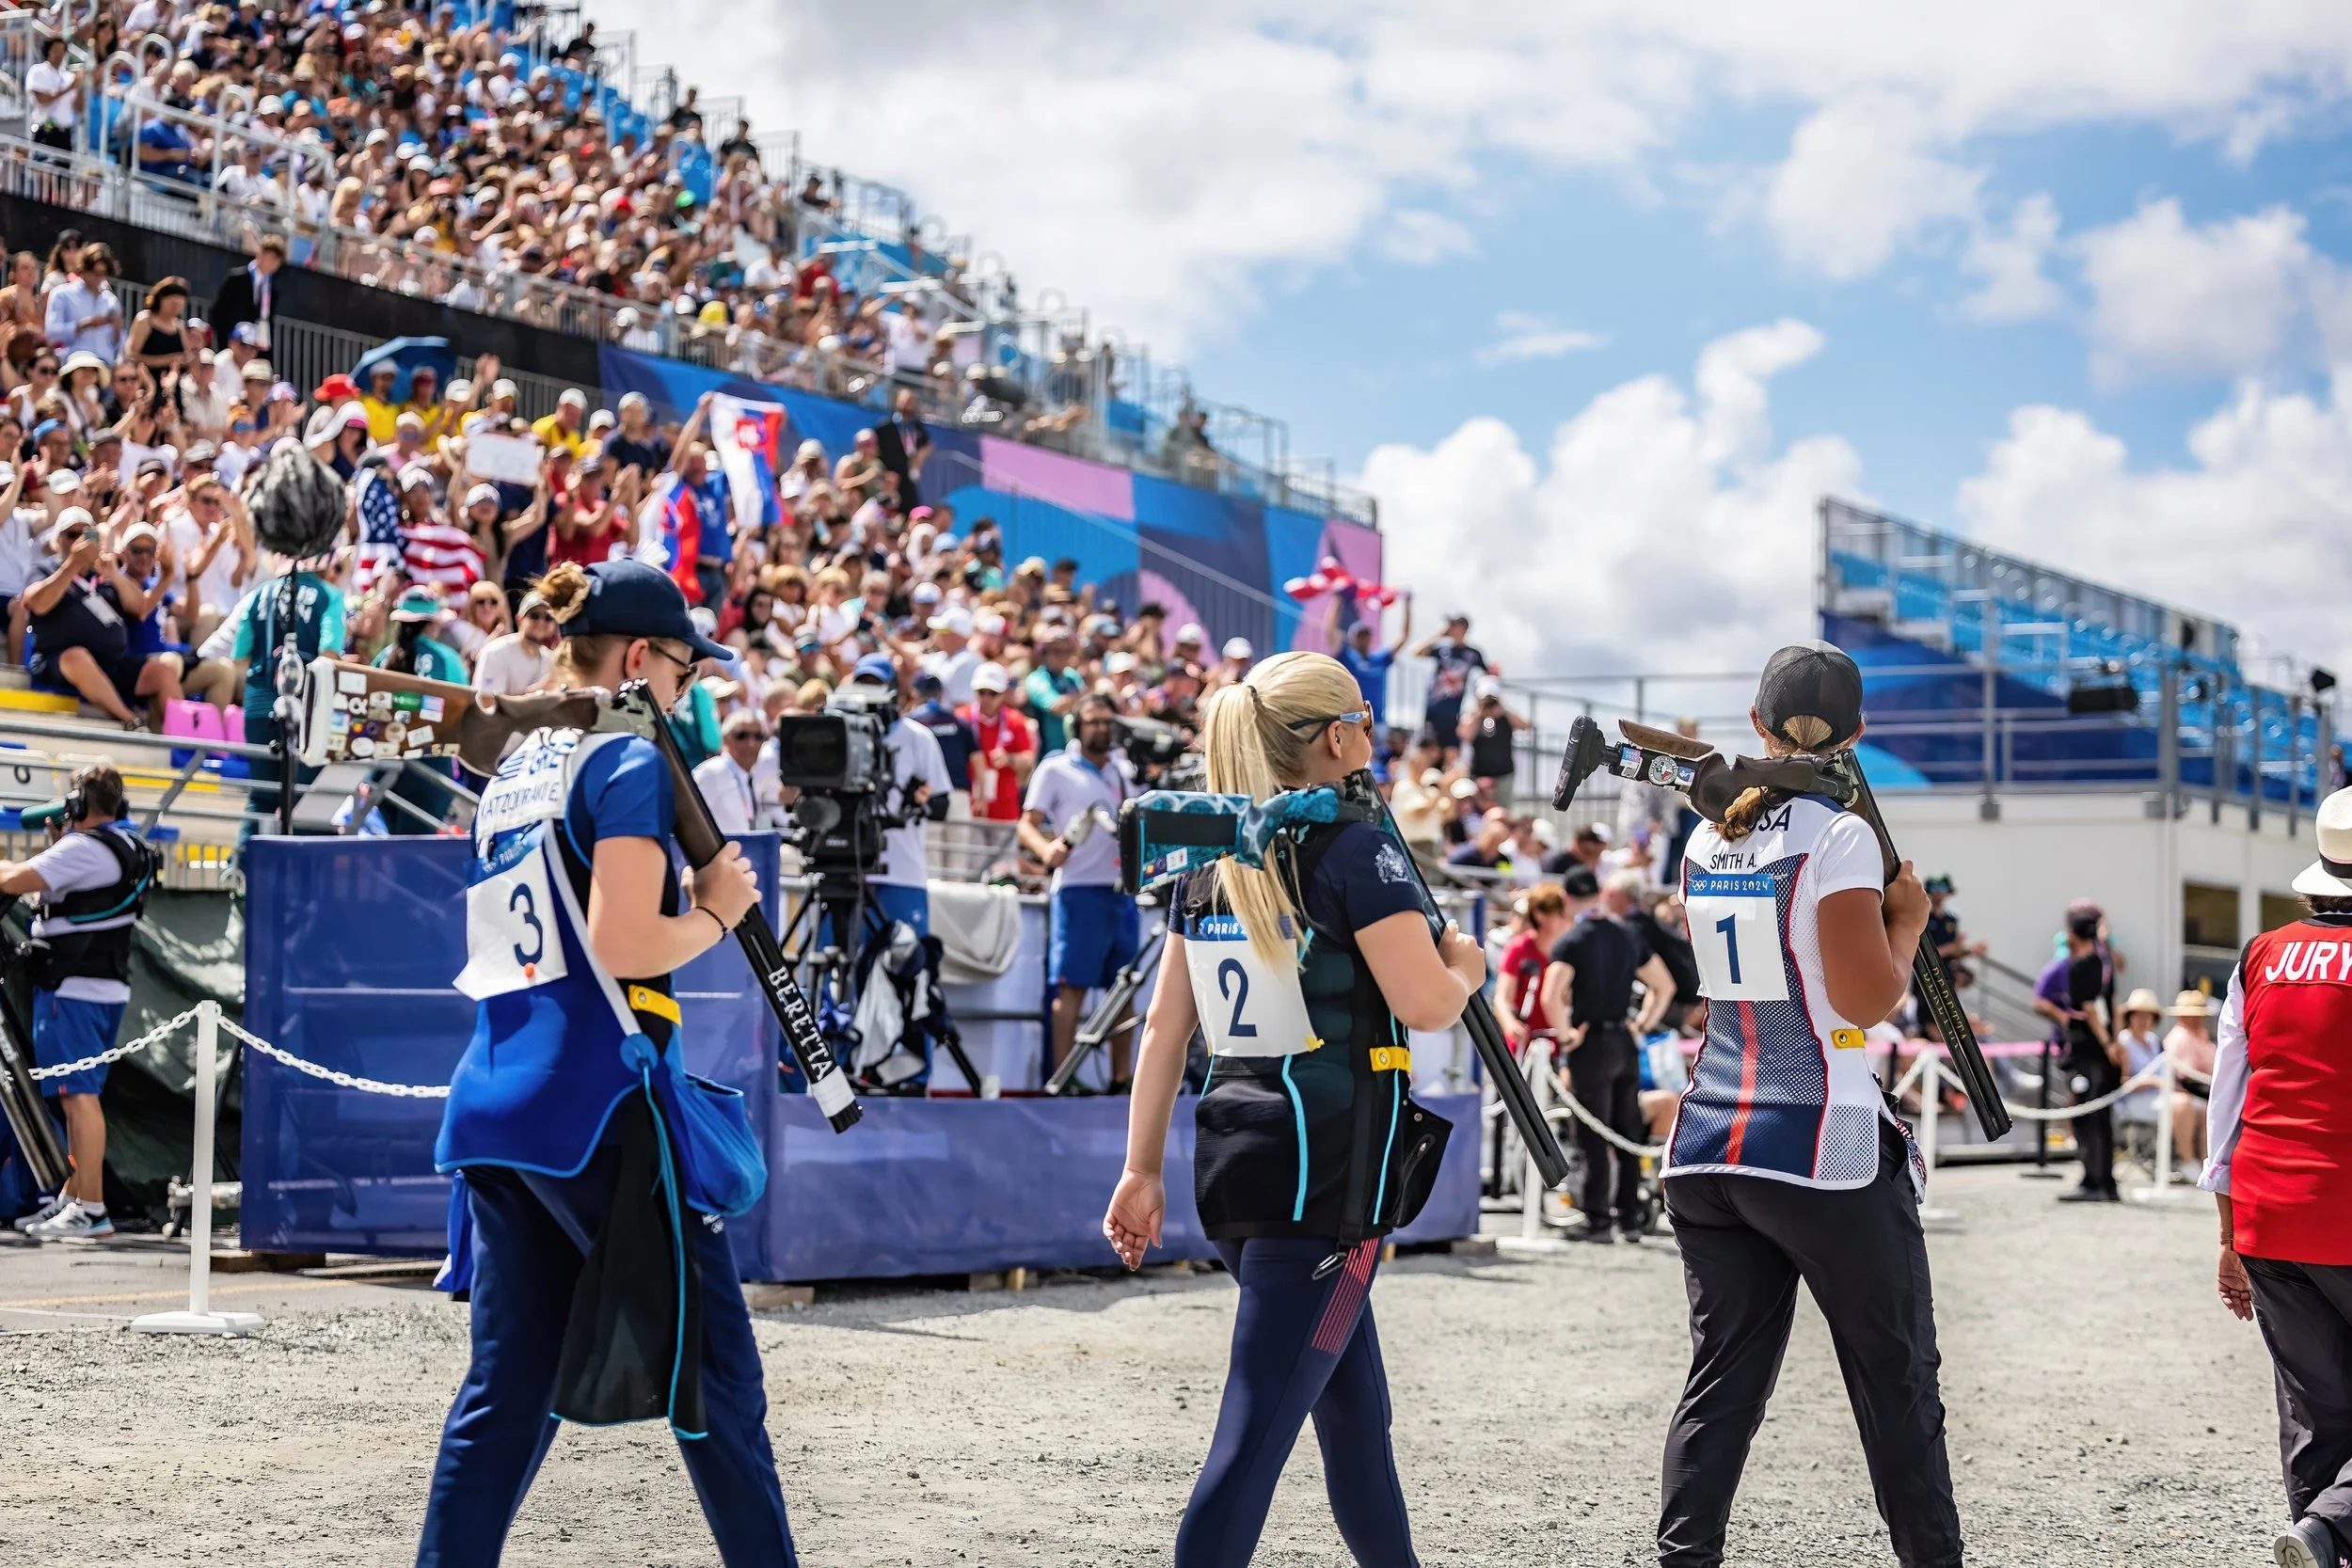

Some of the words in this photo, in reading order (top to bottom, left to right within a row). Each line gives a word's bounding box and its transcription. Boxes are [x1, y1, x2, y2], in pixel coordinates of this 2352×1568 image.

[1709, 852, 1744, 870] SMITH
[1746, 852, 1757, 868] A.
[1742, 879, 1769, 891] 2024
[509, 882, 543, 968] 3
[1715, 912, 1742, 984] 1
[1217, 958, 1258, 1037] 2
[2265, 941, 2352, 982] JURY
[768, 965, 834, 1082] BERETTA
